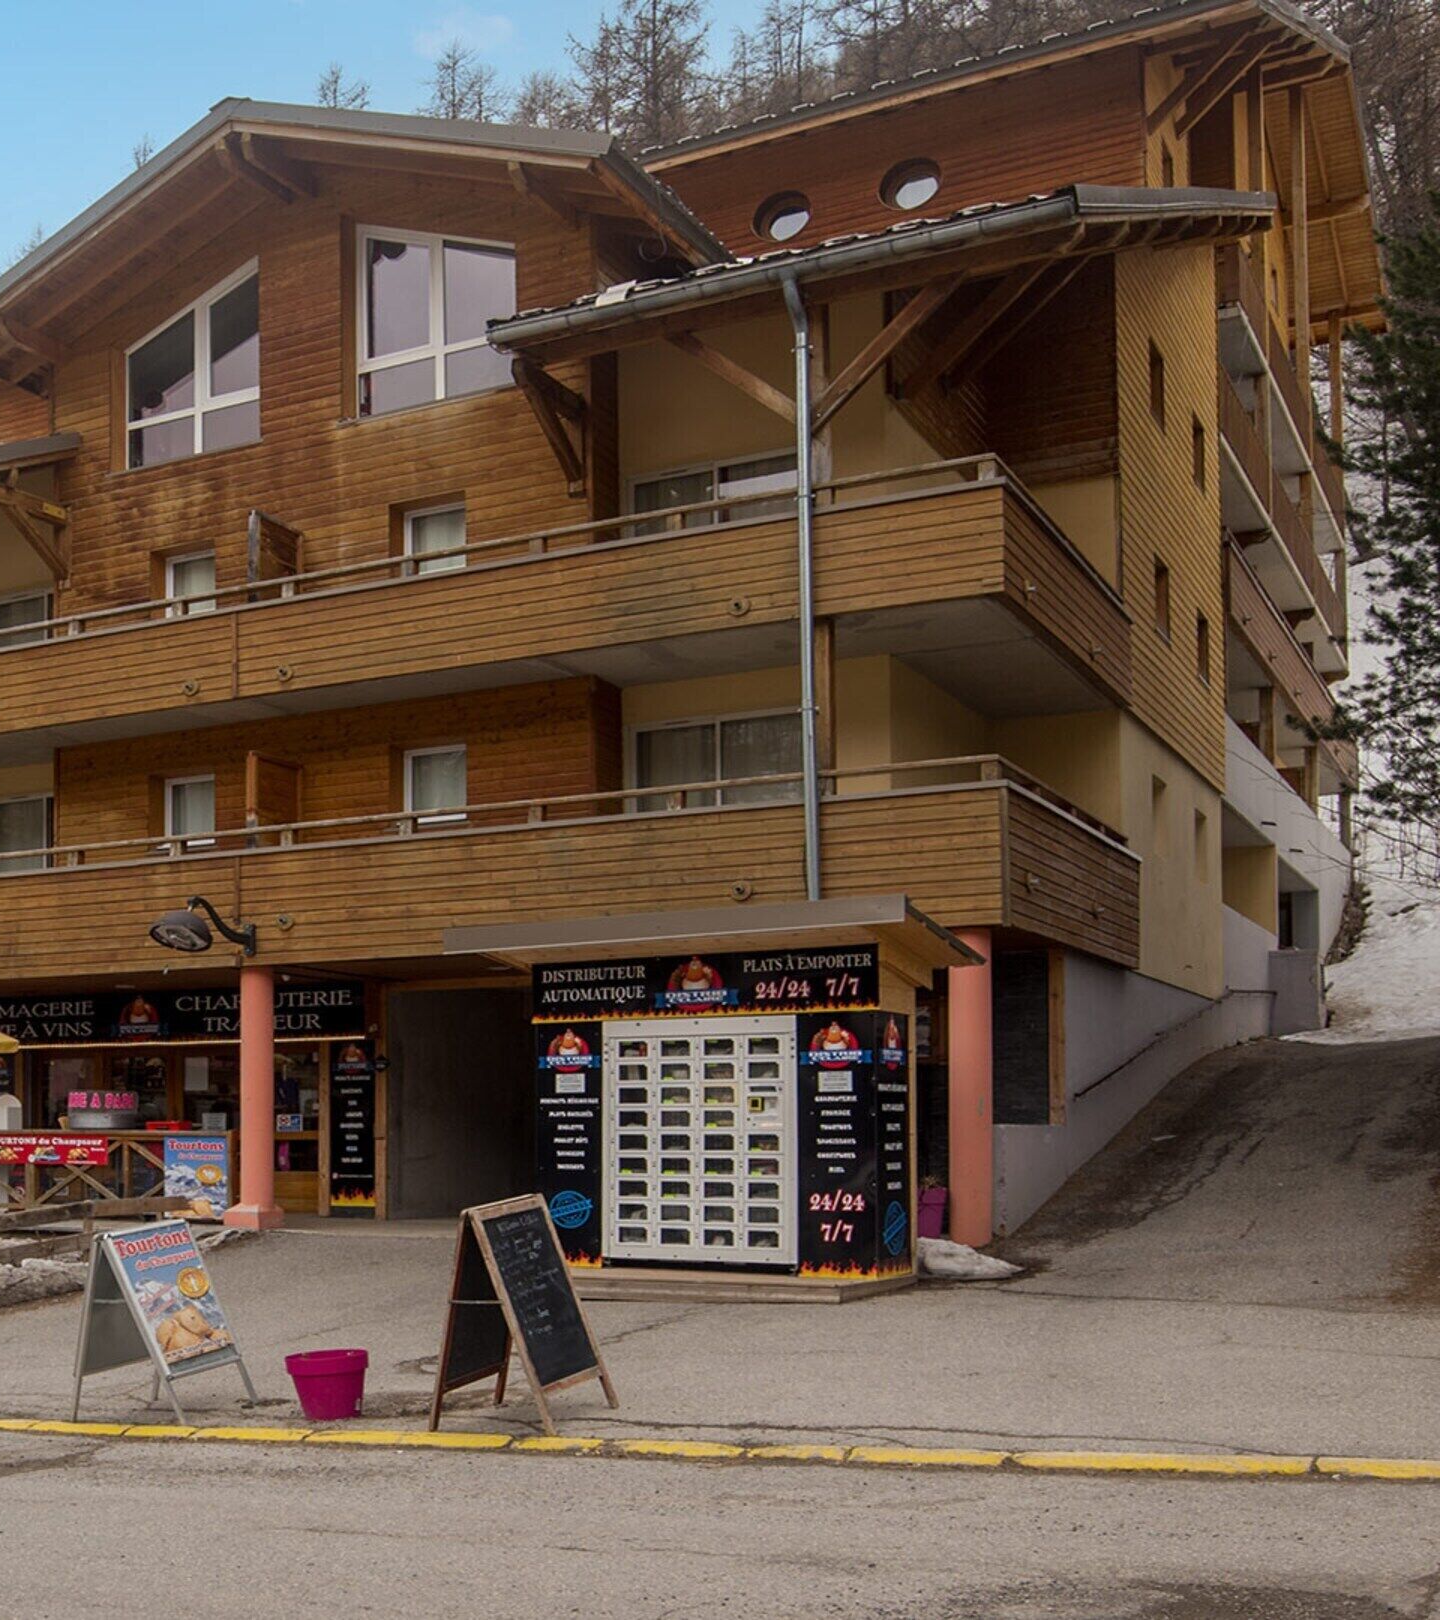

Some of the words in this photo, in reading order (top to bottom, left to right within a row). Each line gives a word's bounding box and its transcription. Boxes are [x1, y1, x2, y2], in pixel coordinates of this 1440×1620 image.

[743, 958, 782, 973] PLATS
[786, 954, 797, 970] À
[798, 953, 872, 970] EMPORTER
[542, 965, 645, 983] DISTRIBUTEUR
[542, 985, 645, 1003] AUTOMATIQUE
[755, 976, 810, 999] 24/24
[825, 973, 859, 997] 7/7
[18, 1020, 39, 1038] À
[42, 1021, 93, 1037] VINS
[38, 1137, 50, 1145] du
[51, 1136, 103, 1147] Champsaur
[168, 1138, 225, 1151] Tourtons
[809, 1188, 865, 1212] 24/24
[821, 1219, 854, 1242] 7/7
[113, 1230, 191, 1259] Tourtons
